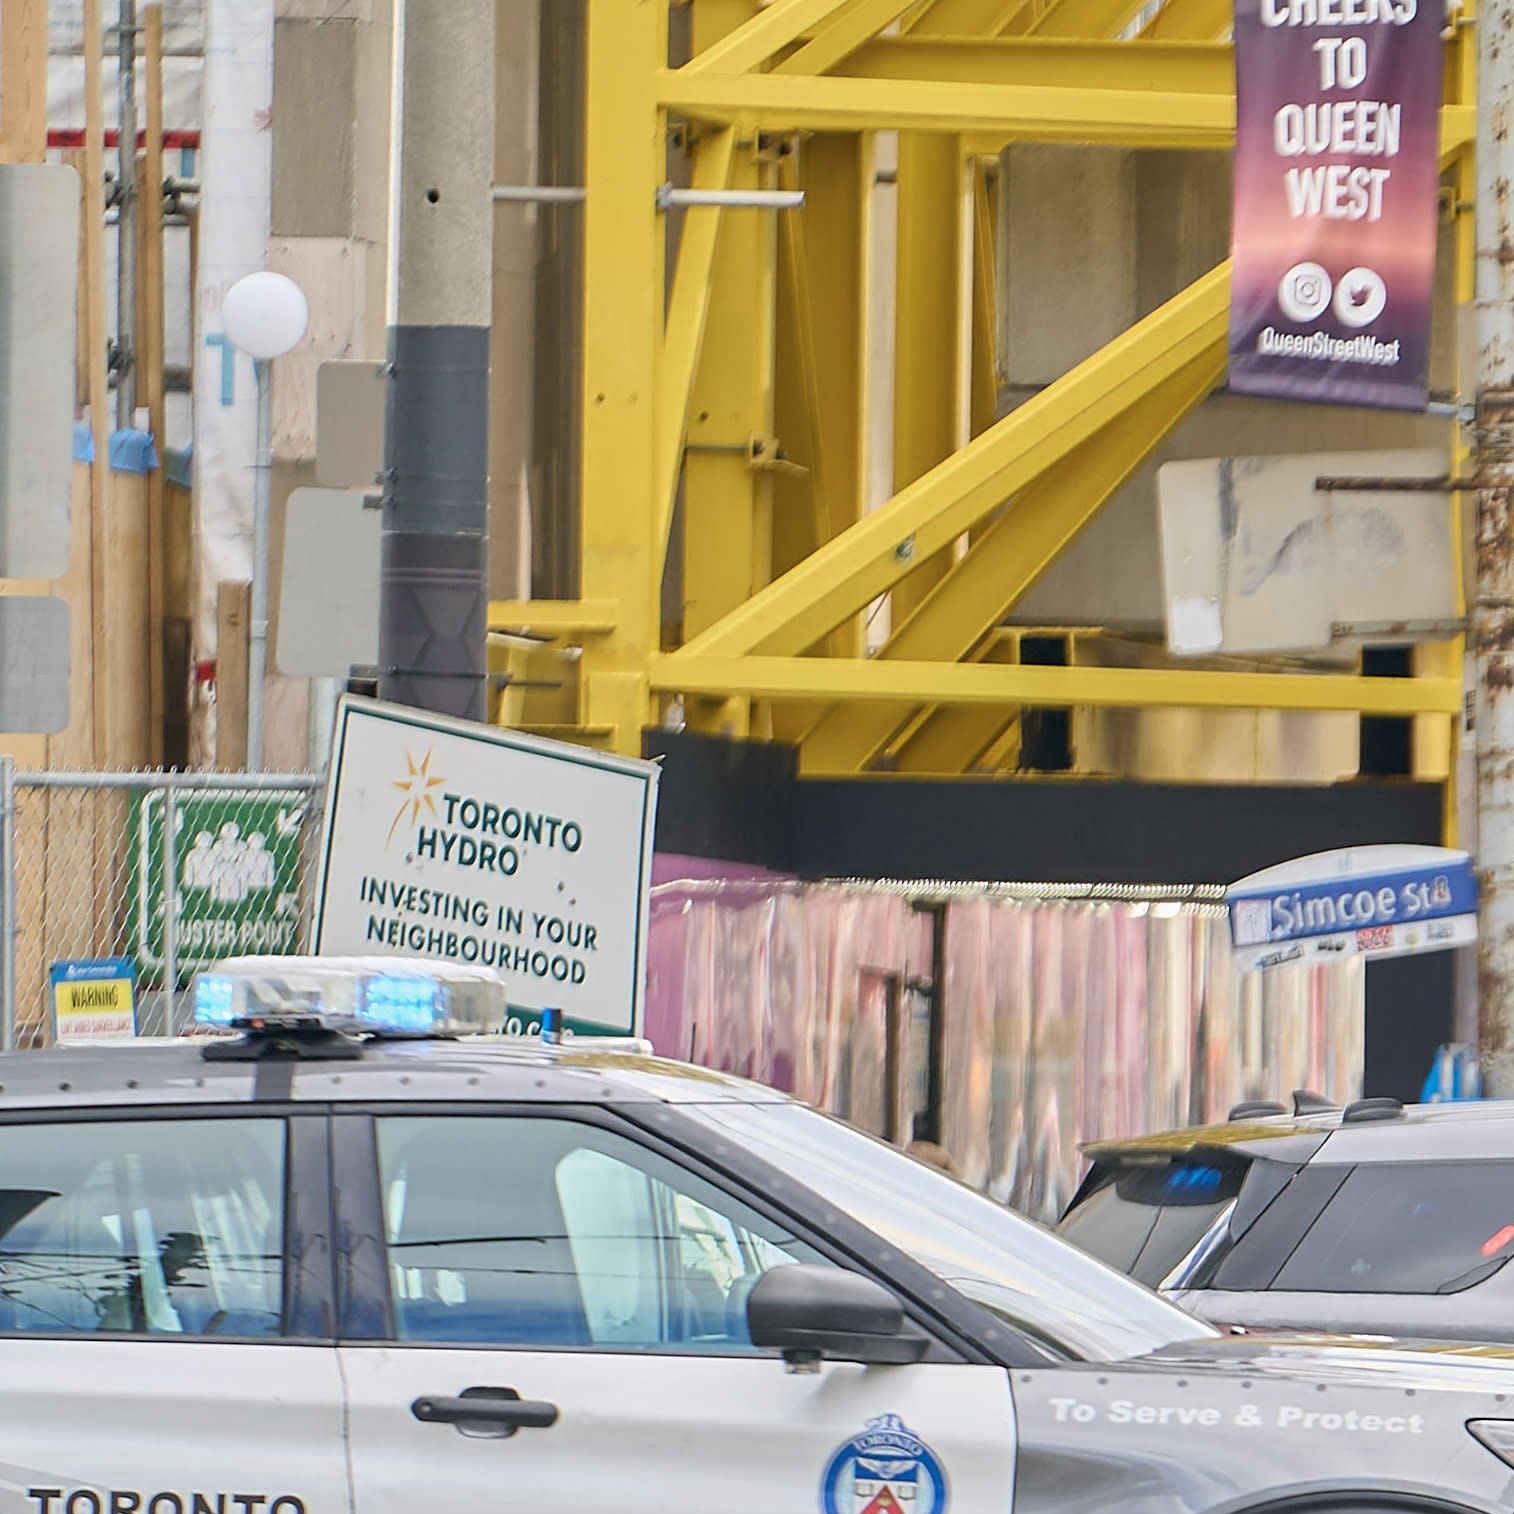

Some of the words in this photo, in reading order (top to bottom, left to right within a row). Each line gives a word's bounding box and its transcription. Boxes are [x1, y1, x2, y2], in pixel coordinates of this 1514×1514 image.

[1312, 37, 1367, 91] TO
[1274, 101, 1400, 157] QUEEN
[1285, 165, 1390, 223] WEST
[1256, 326, 1400, 366] QueenStreetWest
[443, 793, 582, 852] TORONTO
[418, 825, 519, 876] HYDRO
[176, 919, 237, 948] USTER
[242, 919, 294, 946] POINT
[360, 875, 489, 927] INVESTING
[497, 905, 524, 935] IN
[532, 912, 597, 950] YOUR
[1271, 886, 1397, 934] Simcoe
[1401, 882, 1433, 913] St
[367, 915, 586, 985] NEIGHBOURHOOD
[71, 984, 118, 1008] WARNING
[1048, 1398, 1096, 1423] To
[1108, 1400, 1221, 1426] Serve
[1234, 1405, 1263, 1427] &
[1277, 1406, 1424, 1434] Protect
